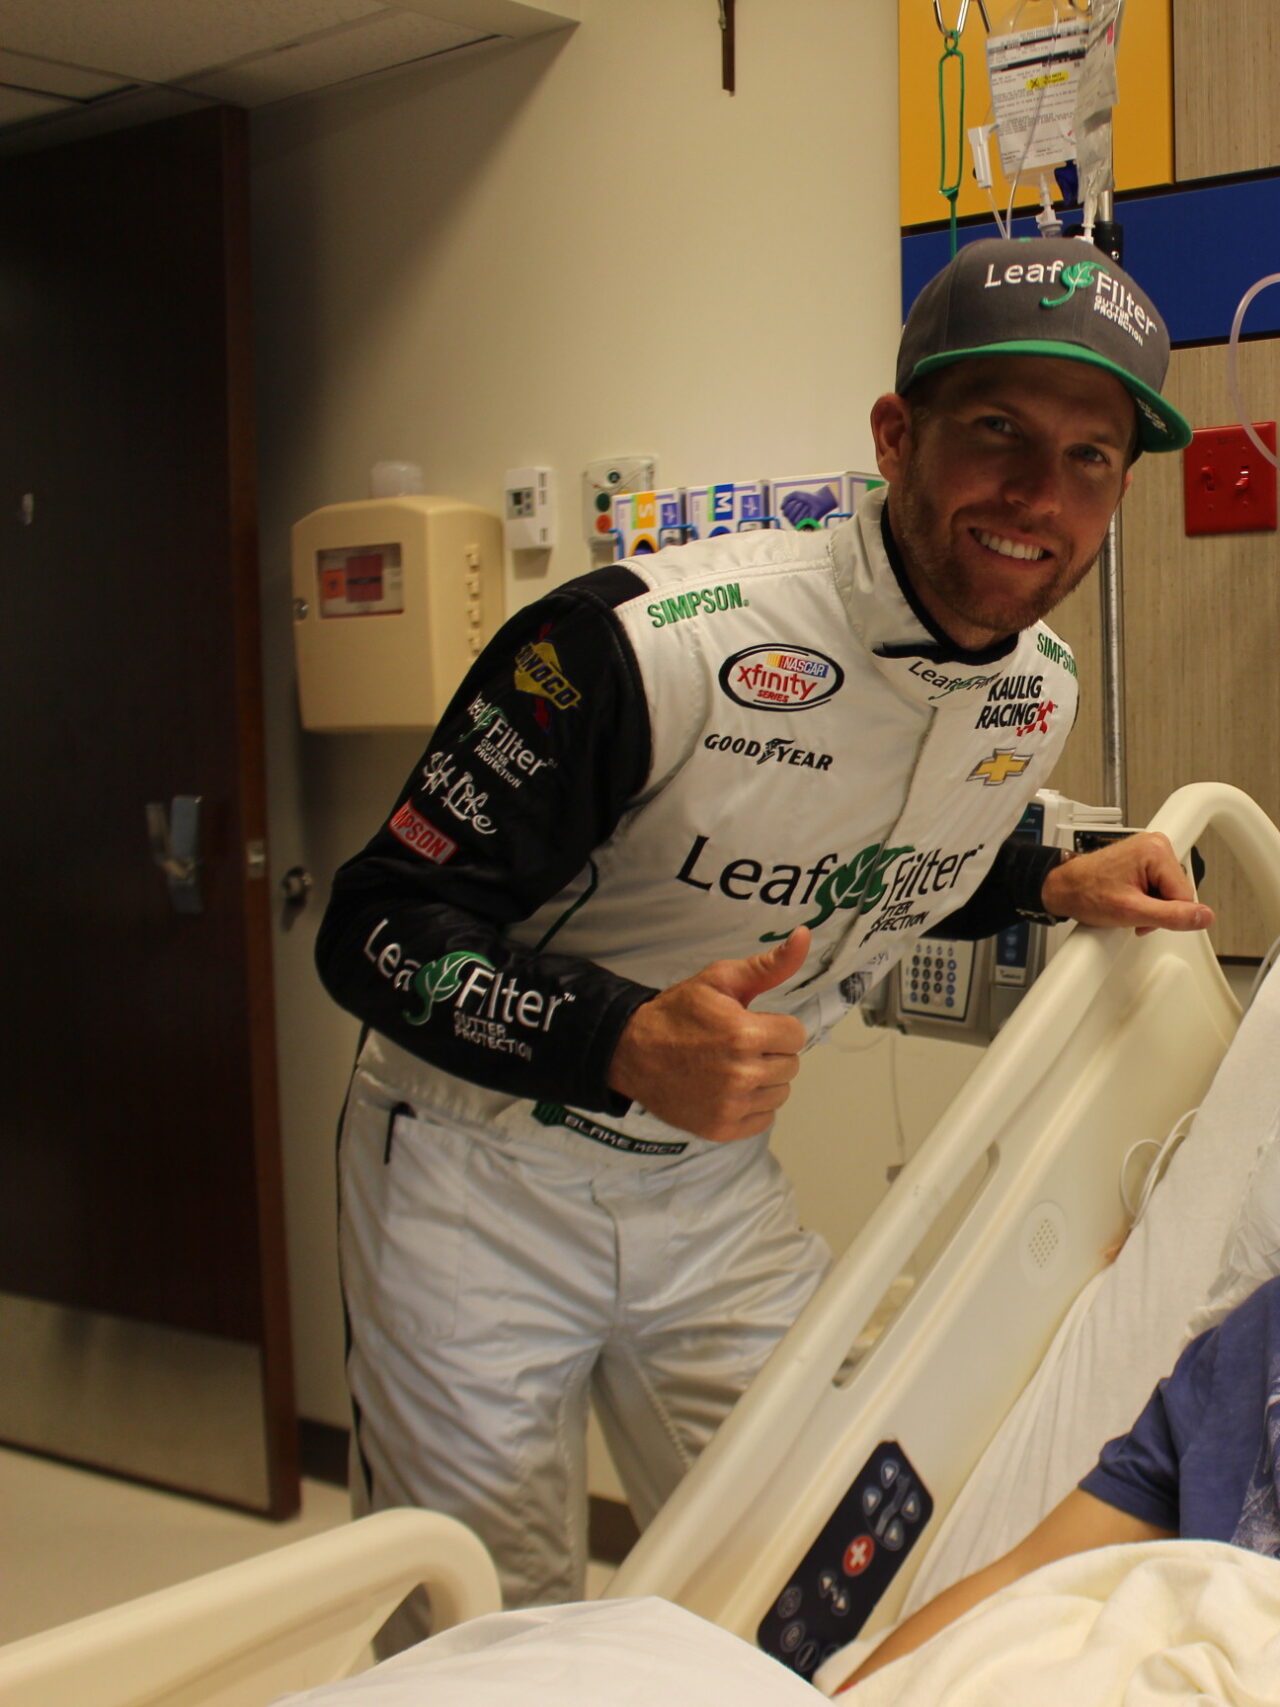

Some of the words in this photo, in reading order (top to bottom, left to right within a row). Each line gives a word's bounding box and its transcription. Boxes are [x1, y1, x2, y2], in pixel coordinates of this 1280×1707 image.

[984, 260, 1064, 288] Leaf
[1096, 271, 1157, 336] Filter
[715, 497, 732, 513] M
[647, 583, 742, 628] SIMPSON
[517, 643, 578, 706] NOCO
[737, 664, 818, 701] xfinity
[783, 656, 827, 677] NASCAR
[757, 689, 790, 703] SERIES
[987, 675, 1043, 702] KAULIG
[975, 703, 1039, 729] RACING
[485, 717, 547, 777] Filter
[675, 834, 838, 906] Leaf
[881, 848, 978, 911] Filter
[565, 1114, 631, 1149] BLAKE
